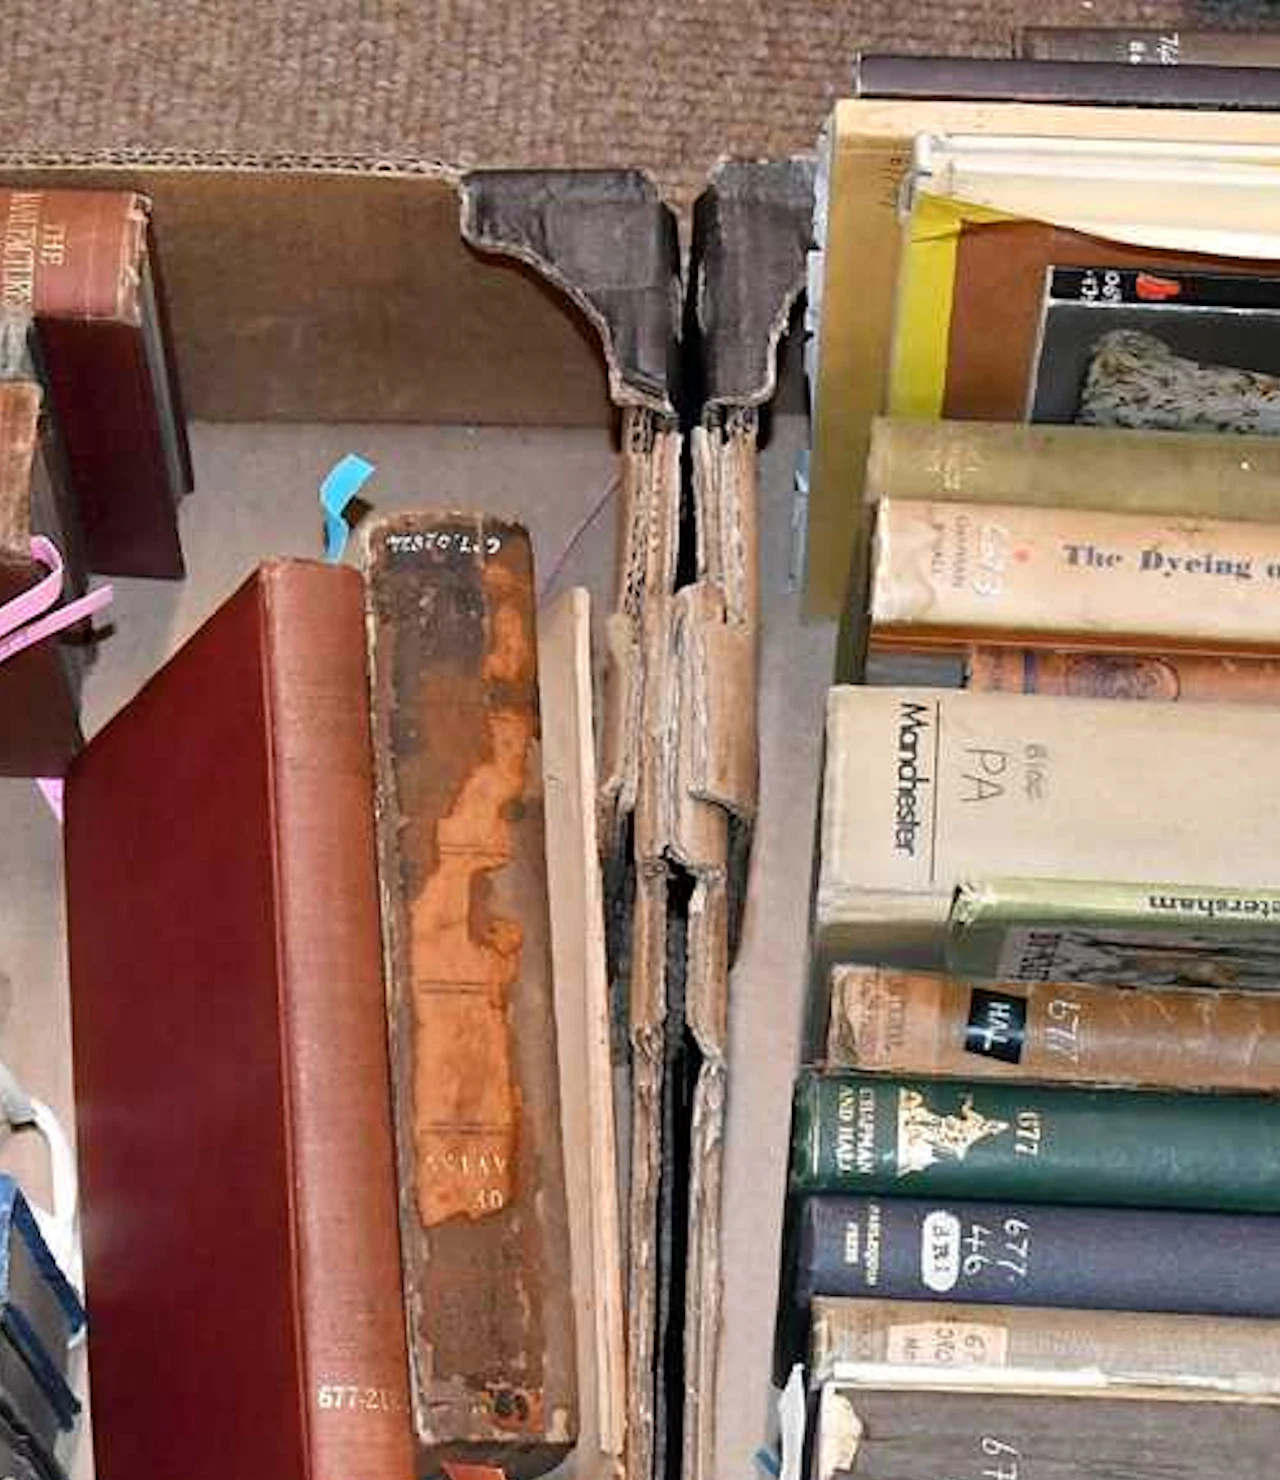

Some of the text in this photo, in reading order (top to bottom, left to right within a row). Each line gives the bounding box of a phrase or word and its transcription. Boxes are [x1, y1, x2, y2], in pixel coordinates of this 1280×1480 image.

[42, 223, 67, 266] THE
[1066, 541, 1123, 569] The
[1139, 546, 1253, 581] Dyeing
[894, 702, 931, 858] Manchester
[959, 748, 1008, 803] PA
[961, 1224, 991, 1276] 46
